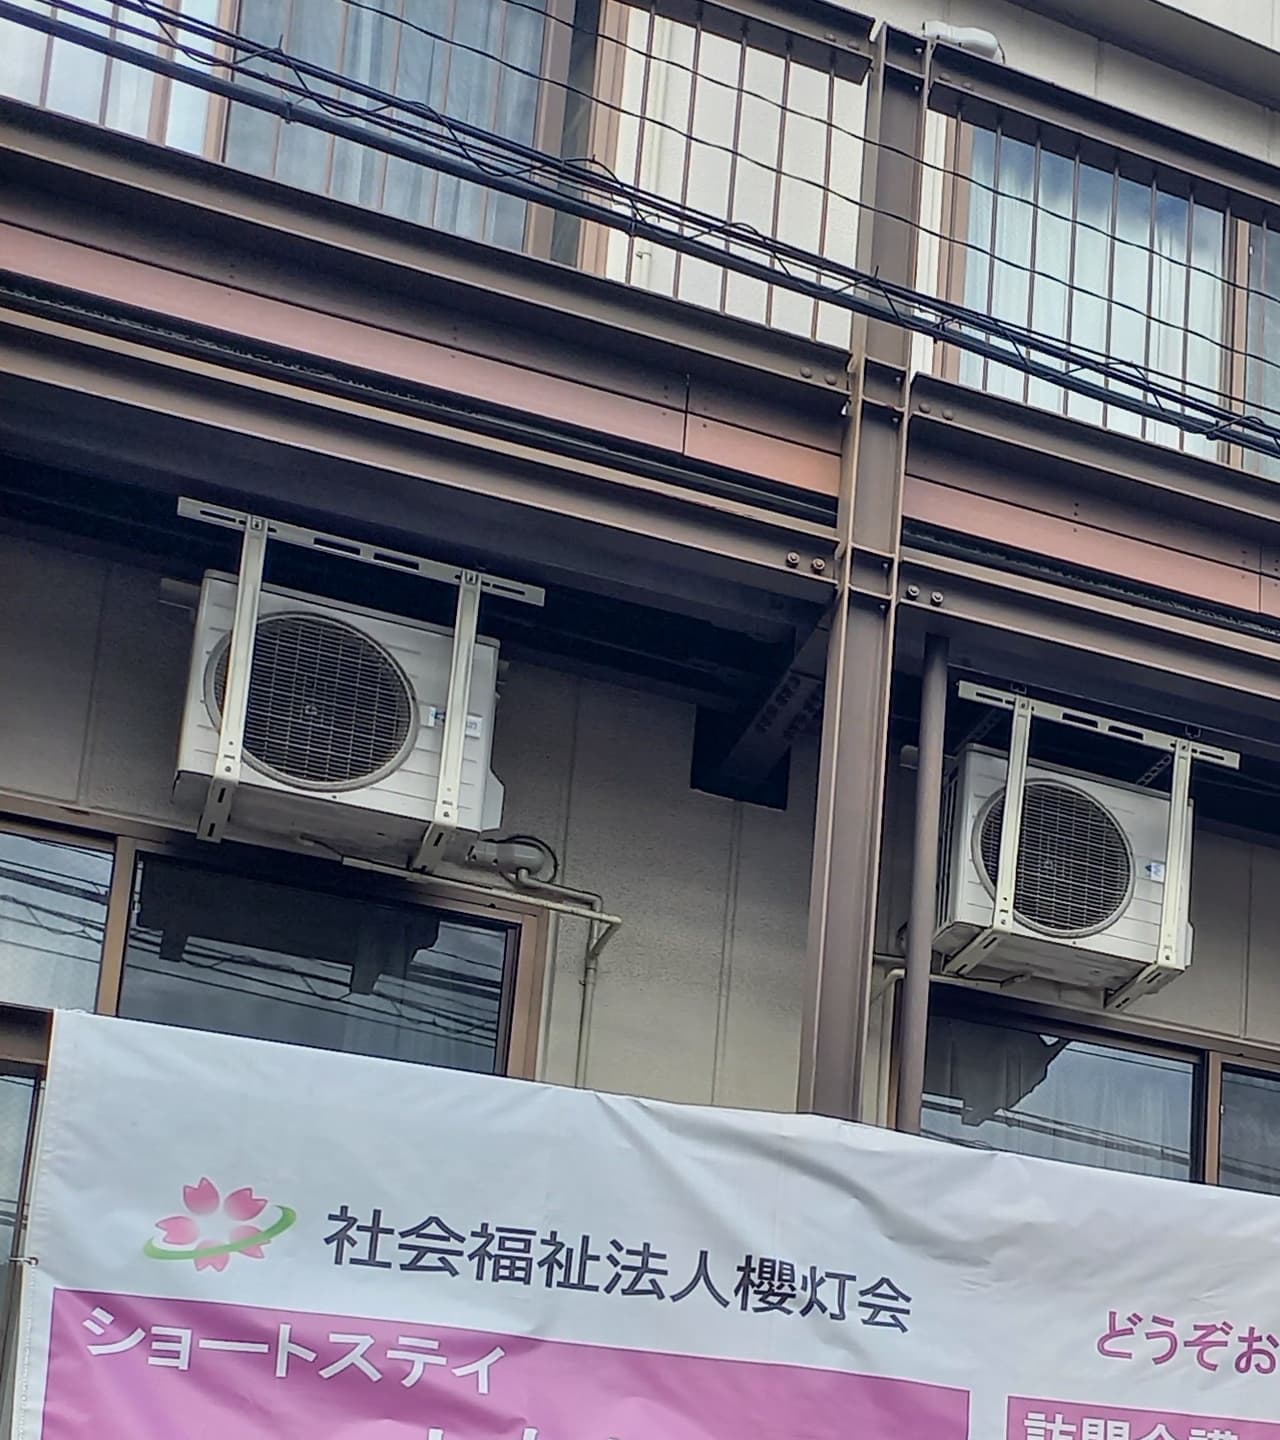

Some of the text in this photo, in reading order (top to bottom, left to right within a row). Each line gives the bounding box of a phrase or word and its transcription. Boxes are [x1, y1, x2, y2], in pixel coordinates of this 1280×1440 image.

[324, 1205, 914, 1333] 社会福祉法人櫻灯会
